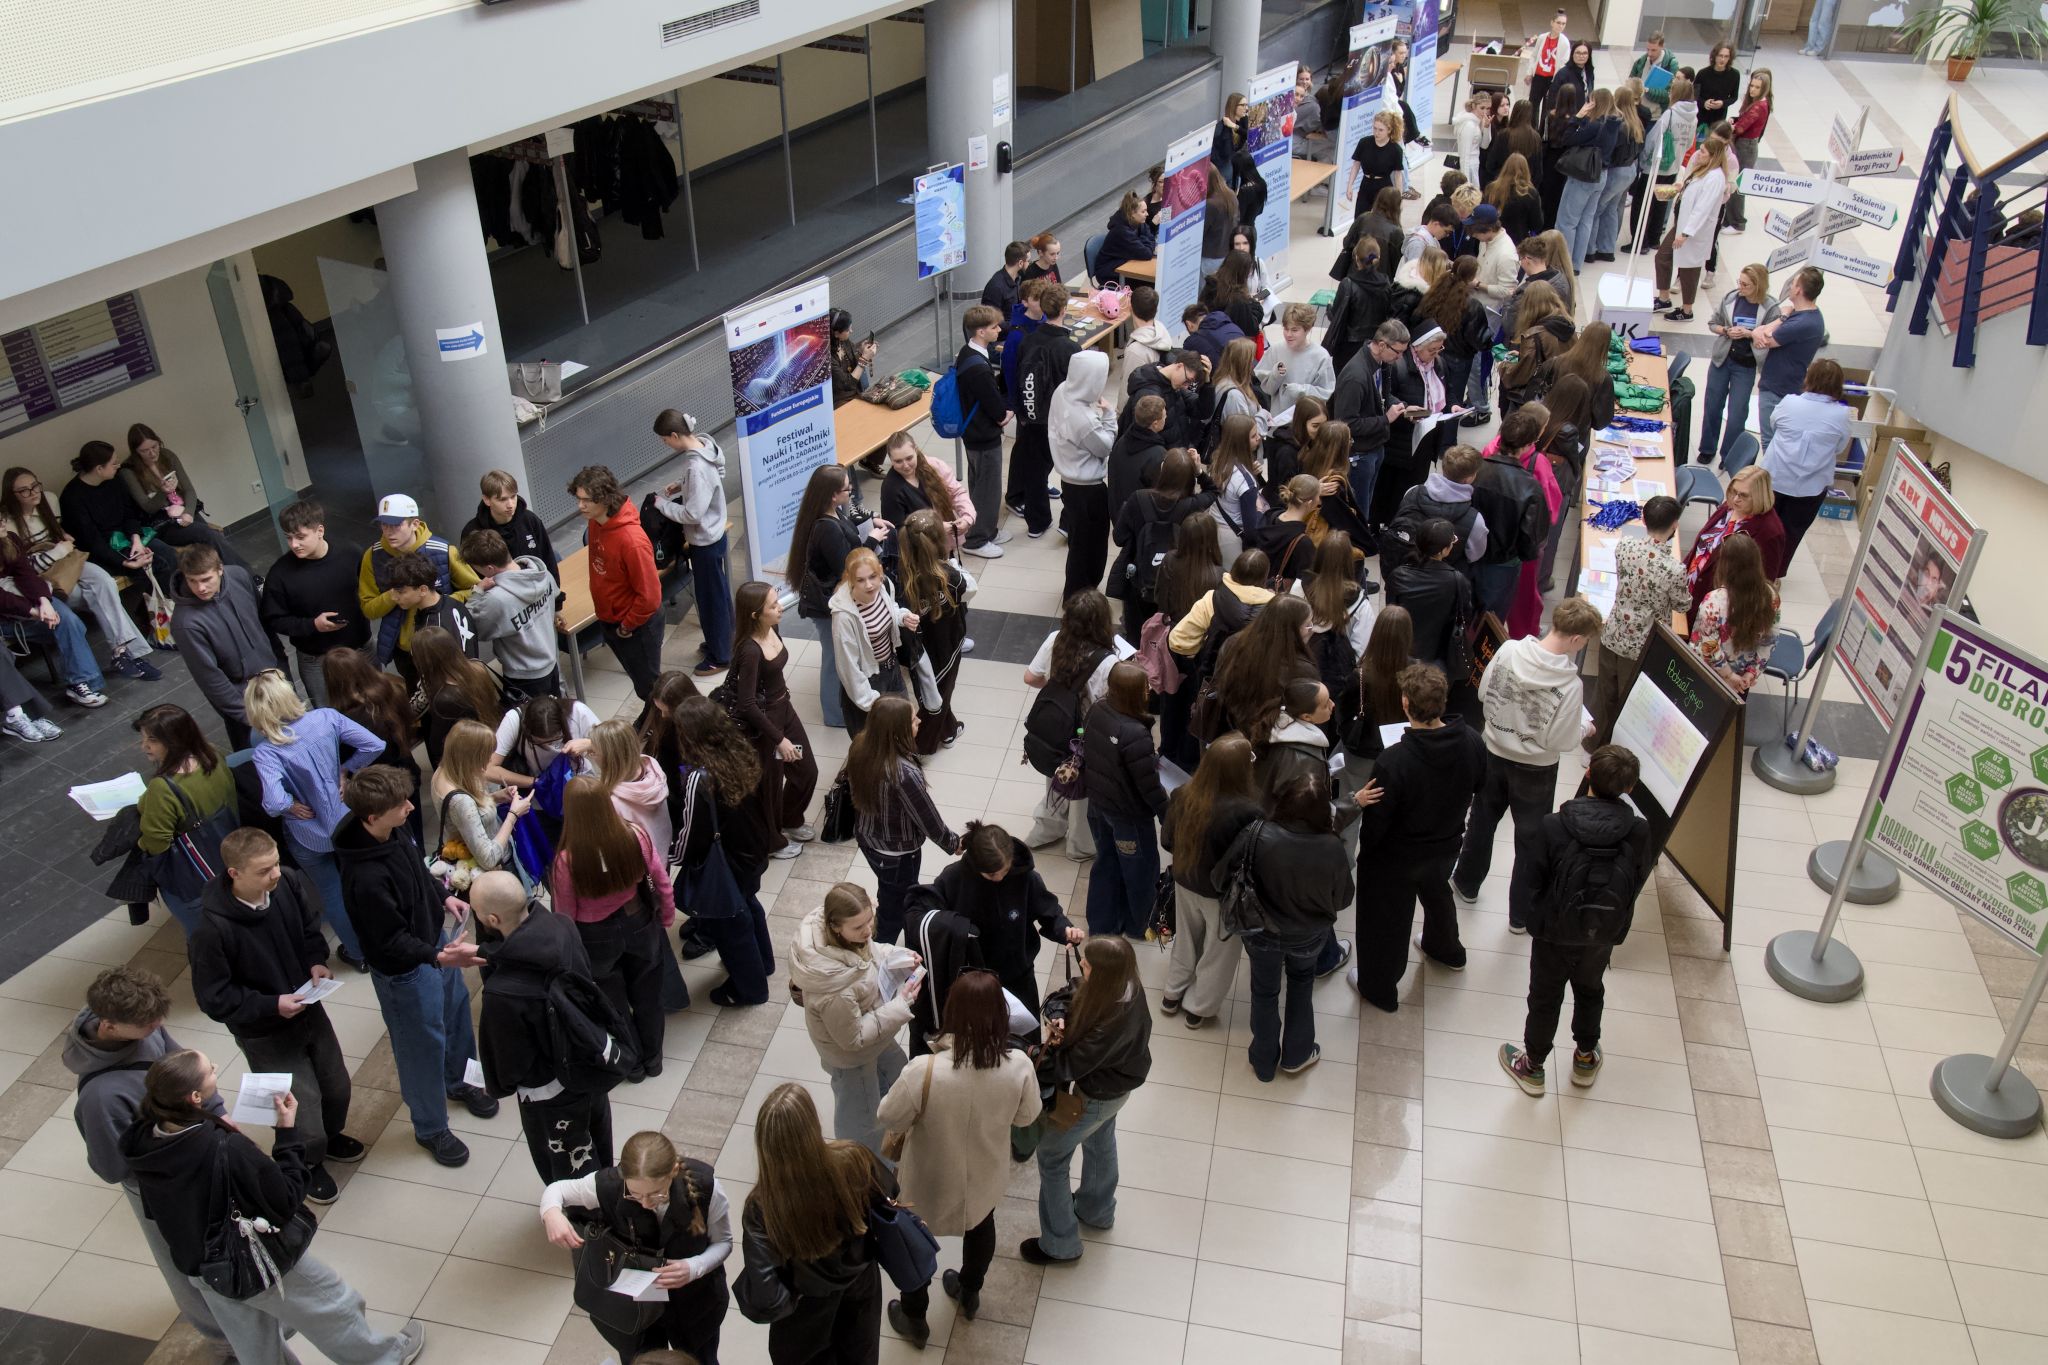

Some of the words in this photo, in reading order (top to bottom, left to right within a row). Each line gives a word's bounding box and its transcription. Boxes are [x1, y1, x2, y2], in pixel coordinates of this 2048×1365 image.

[1849, 151, 1892, 162] Akademickie
[1853, 163, 1869, 172] Targi
[1870, 161, 1889, 170] Pracy
[1751, 183, 1764, 191] CV
[1770, 186, 1783, 194] LM
[1753, 173, 1813, 188] Redagowanie
[1842, 202, 1862, 214] rynku
[1863, 210, 1883, 222] pracy
[1852, 193, 1886, 211] Szkolenia
[1821, 248, 1848, 261] Szefowa
[1849, 257, 1881, 270] własnego
[1844, 264, 1878, 278] wizerunku
[1022, 372, 1037, 420] adidas
[777, 422, 813, 446] Festiwal
[762, 445, 788, 466] Nauki
[789, 443, 792, 452] i
[794, 426, 830, 450] Techniki
[773, 455, 795, 470] ramach
[795, 442, 823, 459] ZADANIA
[823, 439, 828, 447] V
[1899, 479, 1921, 508] ABK
[1928, 509, 1959, 549] NEWS
[1945, 639, 1977, 685] 5
[1976, 653, 2048, 706] FILA
[1968, 672, 2048, 738] DOBRO
[1992, 753, 2003, 763] 02
[1965, 779, 1975, 789] 03
[1980, 826, 1989, 836] 04
[1880, 815, 1937, 864] DOBROSTAN
[1934, 860, 1976, 892] BUDUJEMY
[1976, 888, 2015, 917] KAŻDEGO
[2015, 913, 2038, 935] DNIA.
[2027, 878, 2038, 889] 05
[1877, 831, 1902, 854] TWORZĄ
[1902, 850, 1912, 859] GO
[1913, 857, 1950, 883] KONKRETNE
[1950, 881, 1981, 904] OBSZARY
[1981, 901, 2013, 925] NASZEGO
[2013, 921, 2035, 941] ŻYCIA.
